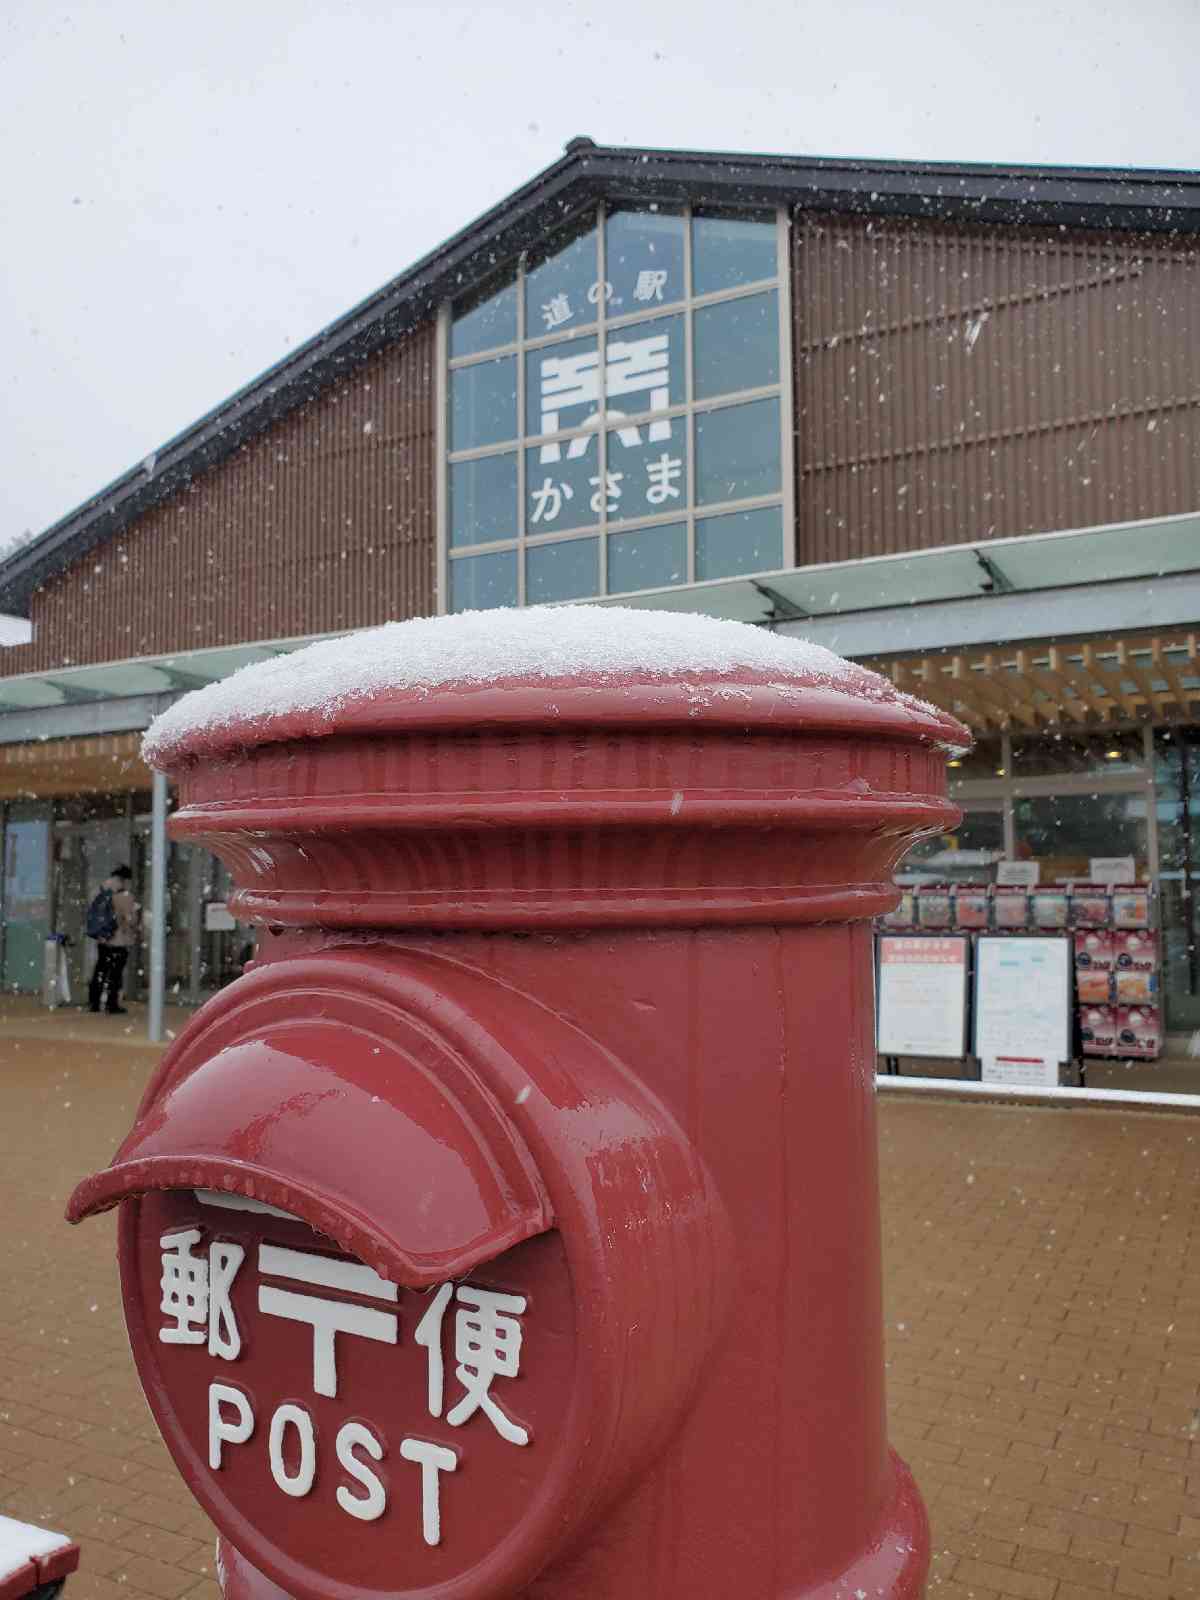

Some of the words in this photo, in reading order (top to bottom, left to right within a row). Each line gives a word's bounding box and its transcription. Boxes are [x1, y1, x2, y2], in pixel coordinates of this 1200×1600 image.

[541, 270, 668, 329] 道の駅
[530, 453, 682, 523] かさま
[208, 1382, 457, 1546] POST
